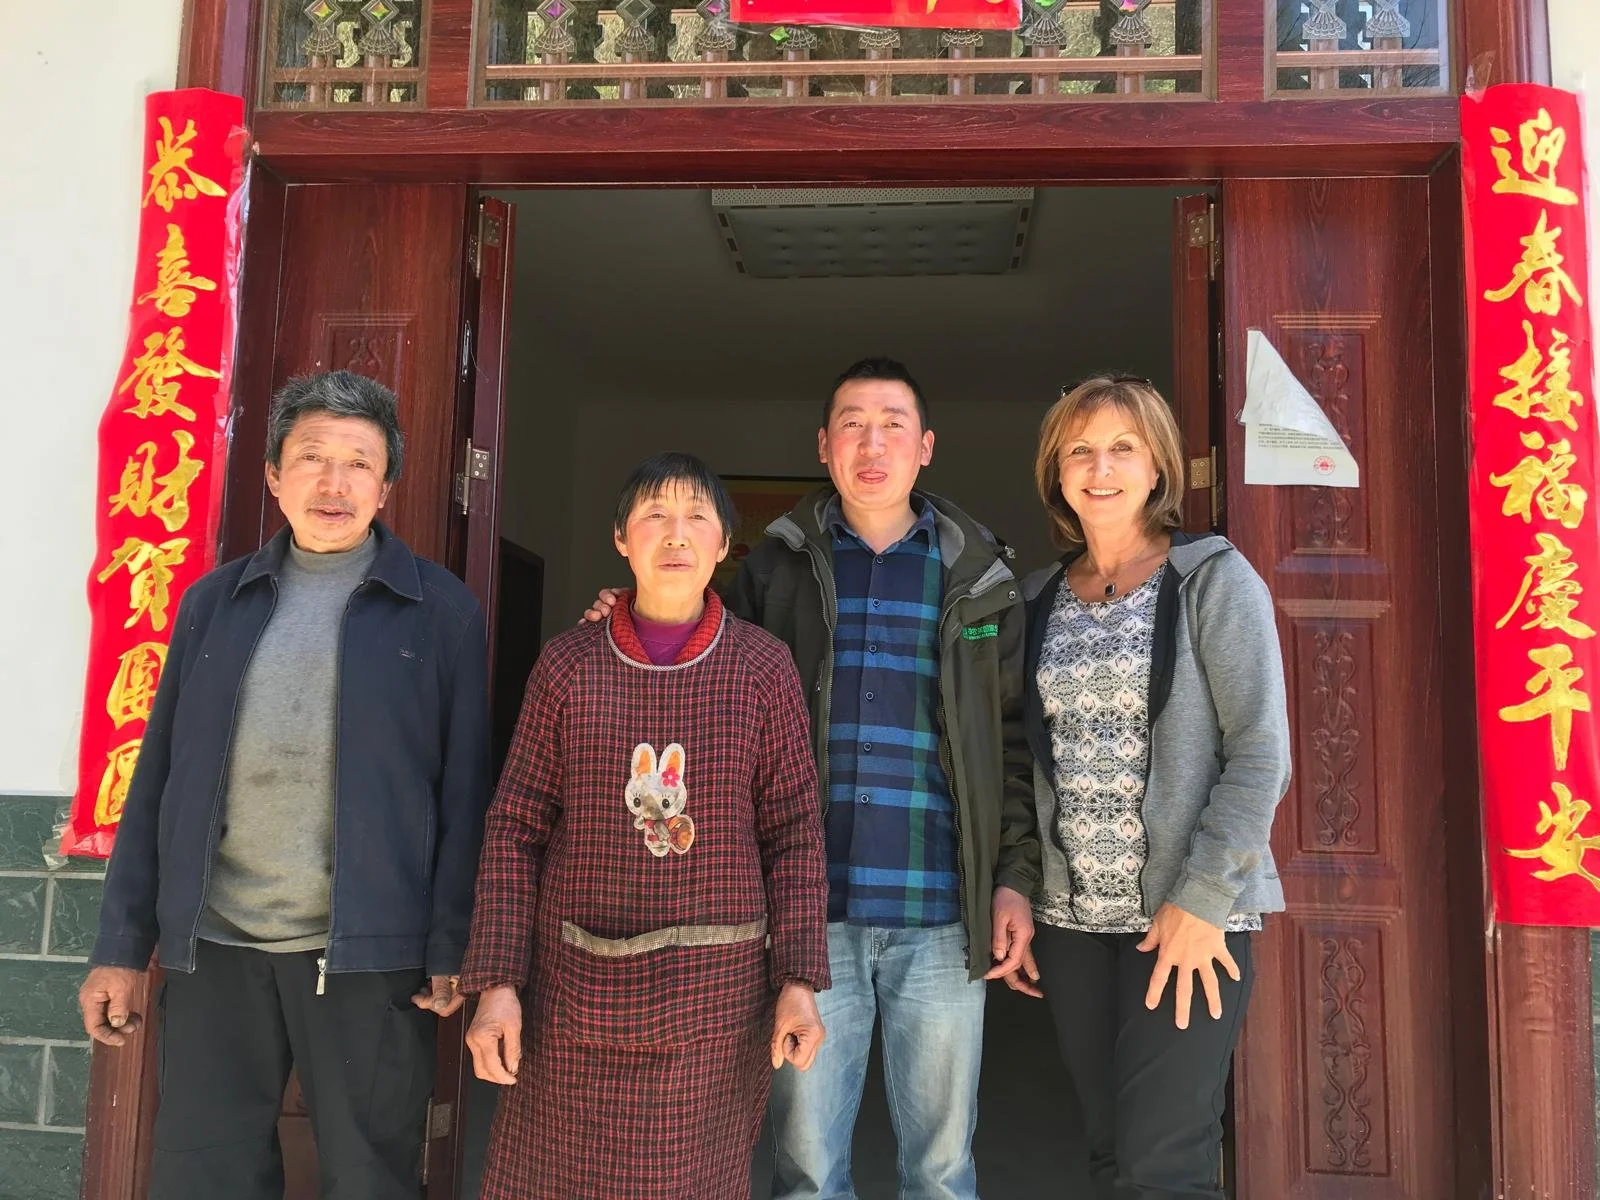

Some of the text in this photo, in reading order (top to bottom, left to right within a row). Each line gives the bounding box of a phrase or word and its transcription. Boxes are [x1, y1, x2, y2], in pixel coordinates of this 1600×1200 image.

[1483, 107, 1600, 893] 迎春接福慶平安
